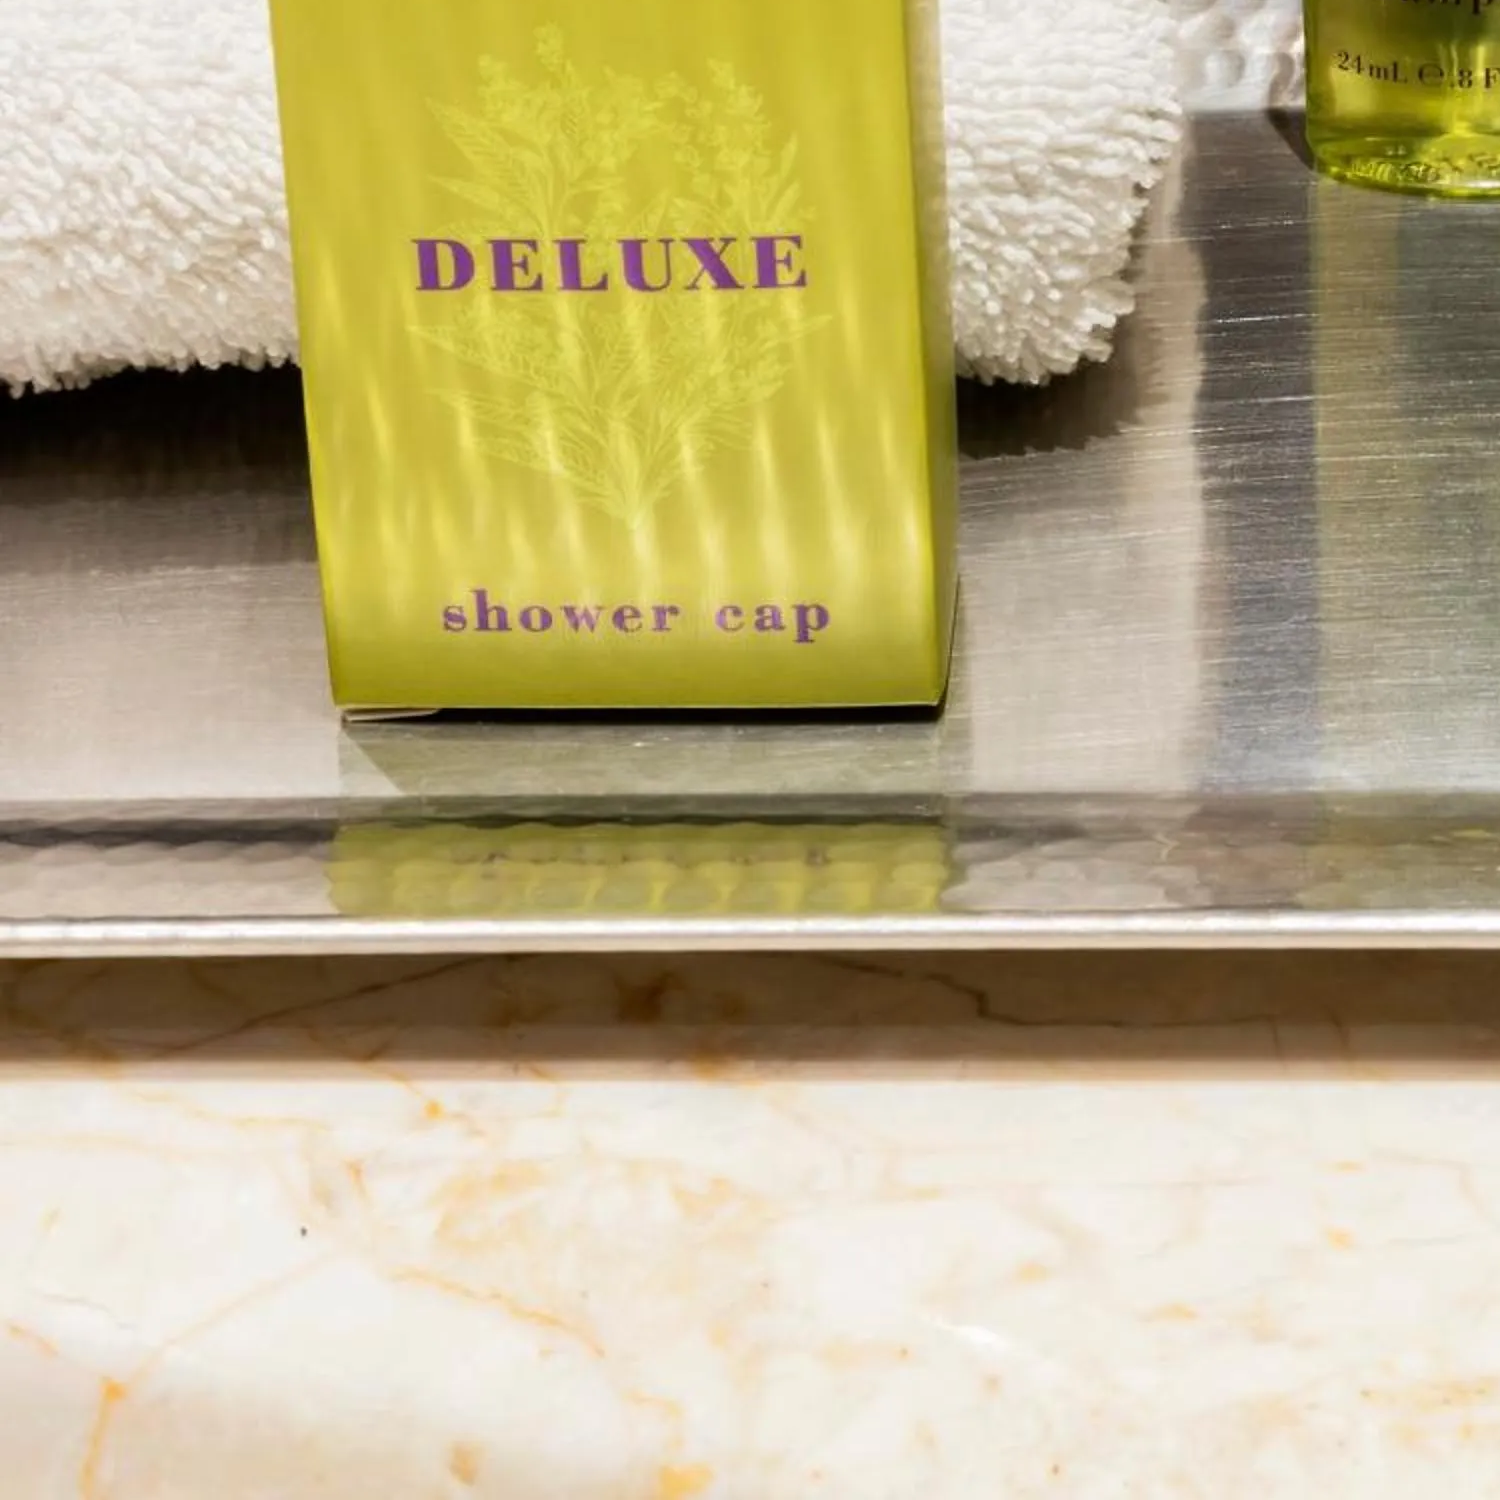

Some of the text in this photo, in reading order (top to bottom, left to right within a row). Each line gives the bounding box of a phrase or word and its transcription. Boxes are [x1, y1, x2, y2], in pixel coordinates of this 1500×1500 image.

[411, 234, 808, 292] DELUXE
[441, 589, 830, 643] shower cap
